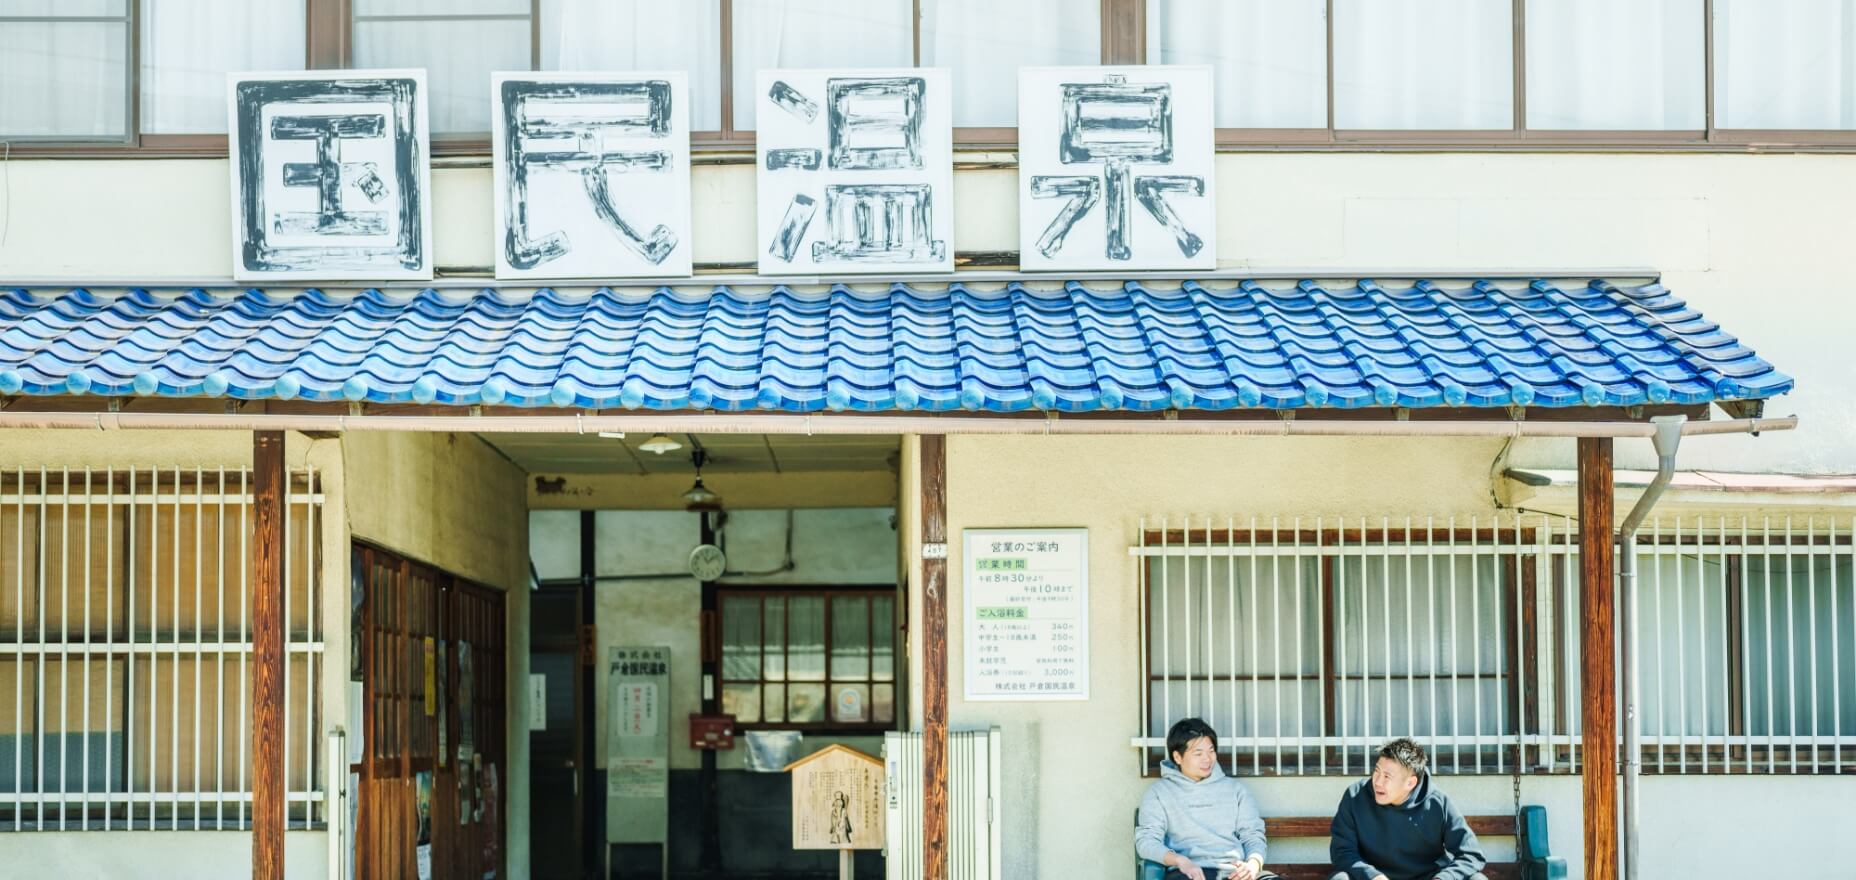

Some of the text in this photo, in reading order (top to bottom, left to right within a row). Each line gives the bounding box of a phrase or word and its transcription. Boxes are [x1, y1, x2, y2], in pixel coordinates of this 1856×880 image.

[237, 73, 1205, 270] 国民温泉
[991, 541, 1059, 553] 営業のご案内
[978, 560, 1025, 570] 営業時間
[979, 608, 1025, 618] ご入浴料金
